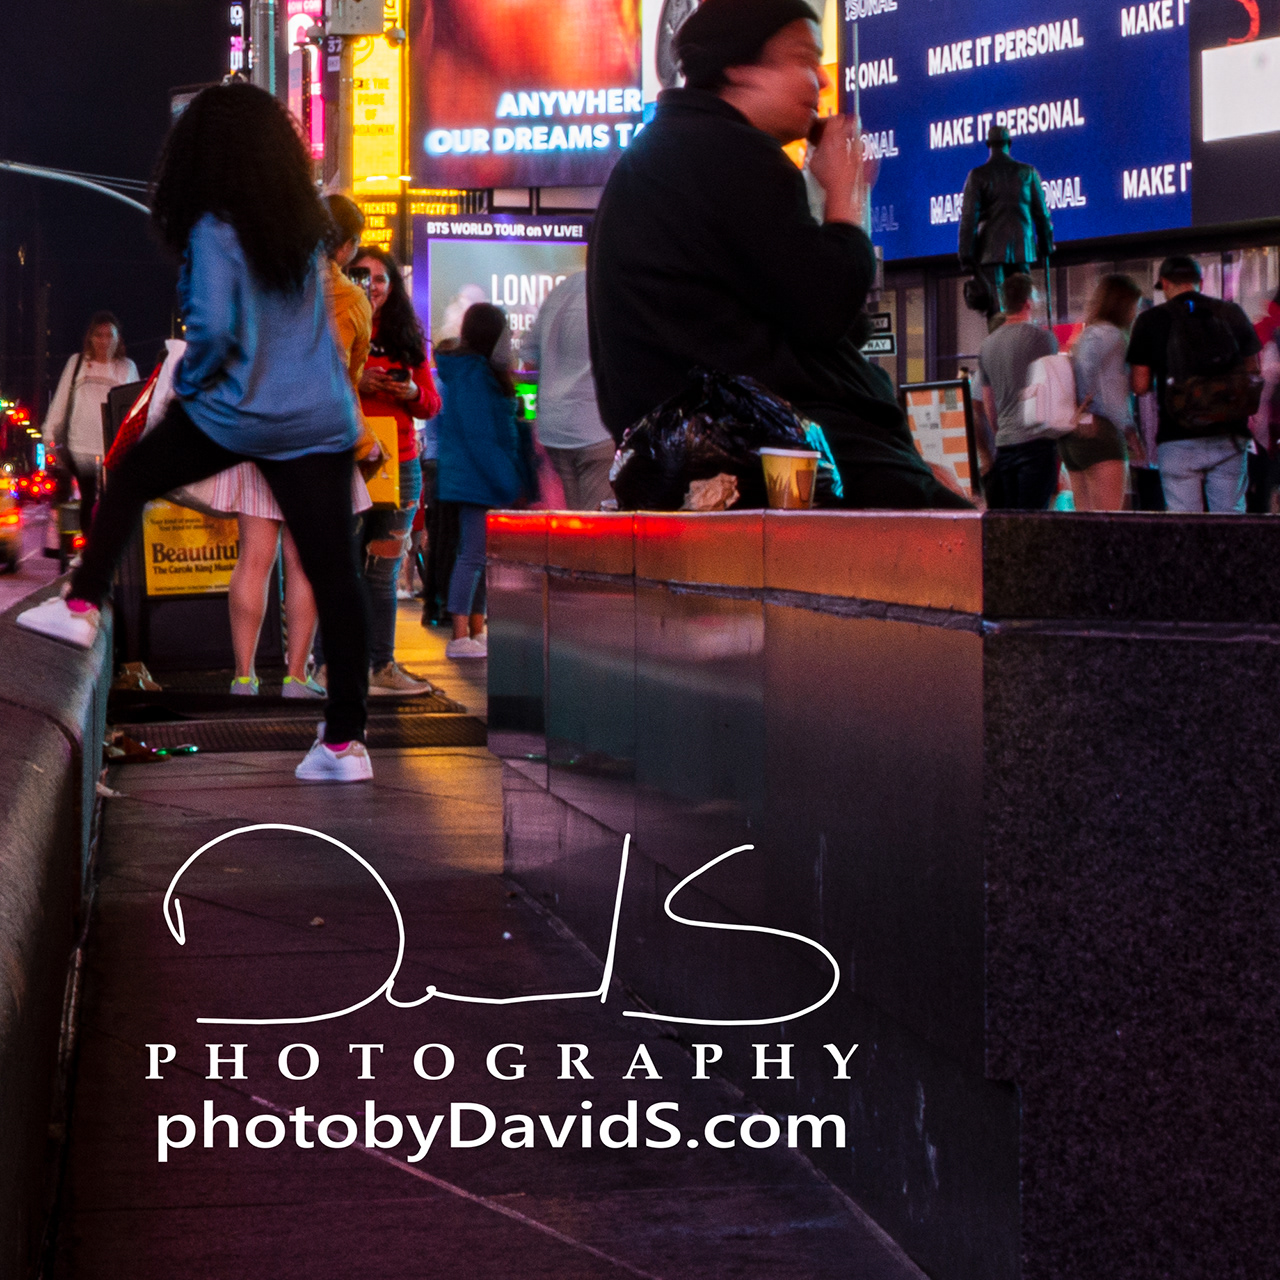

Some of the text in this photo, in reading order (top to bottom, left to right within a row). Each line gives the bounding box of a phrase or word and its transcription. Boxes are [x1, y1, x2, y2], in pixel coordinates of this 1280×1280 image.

[1120, 0, 1175, 38] MAKE
[927, 17, 1085, 77] MAKE IT PERSONAL
[357, 93, 385, 106] PRIDE
[372, 77, 390, 90] THE
[364, 108, 378, 121] OF
[495, 87, 644, 119] ANYWHER
[426, 127, 491, 156] OUR
[492, 123, 611, 154] DREAMS
[929, 116, 975, 150] MAKE
[977, 113, 993, 142] IT
[995, 97, 1086, 138] PERSONAL
[1123, 163, 1176, 200] MAKE
[426, 221, 584, 239] BTS WORLD TOUR on V LIVE!
[151, 539, 239, 564] Beautiful
